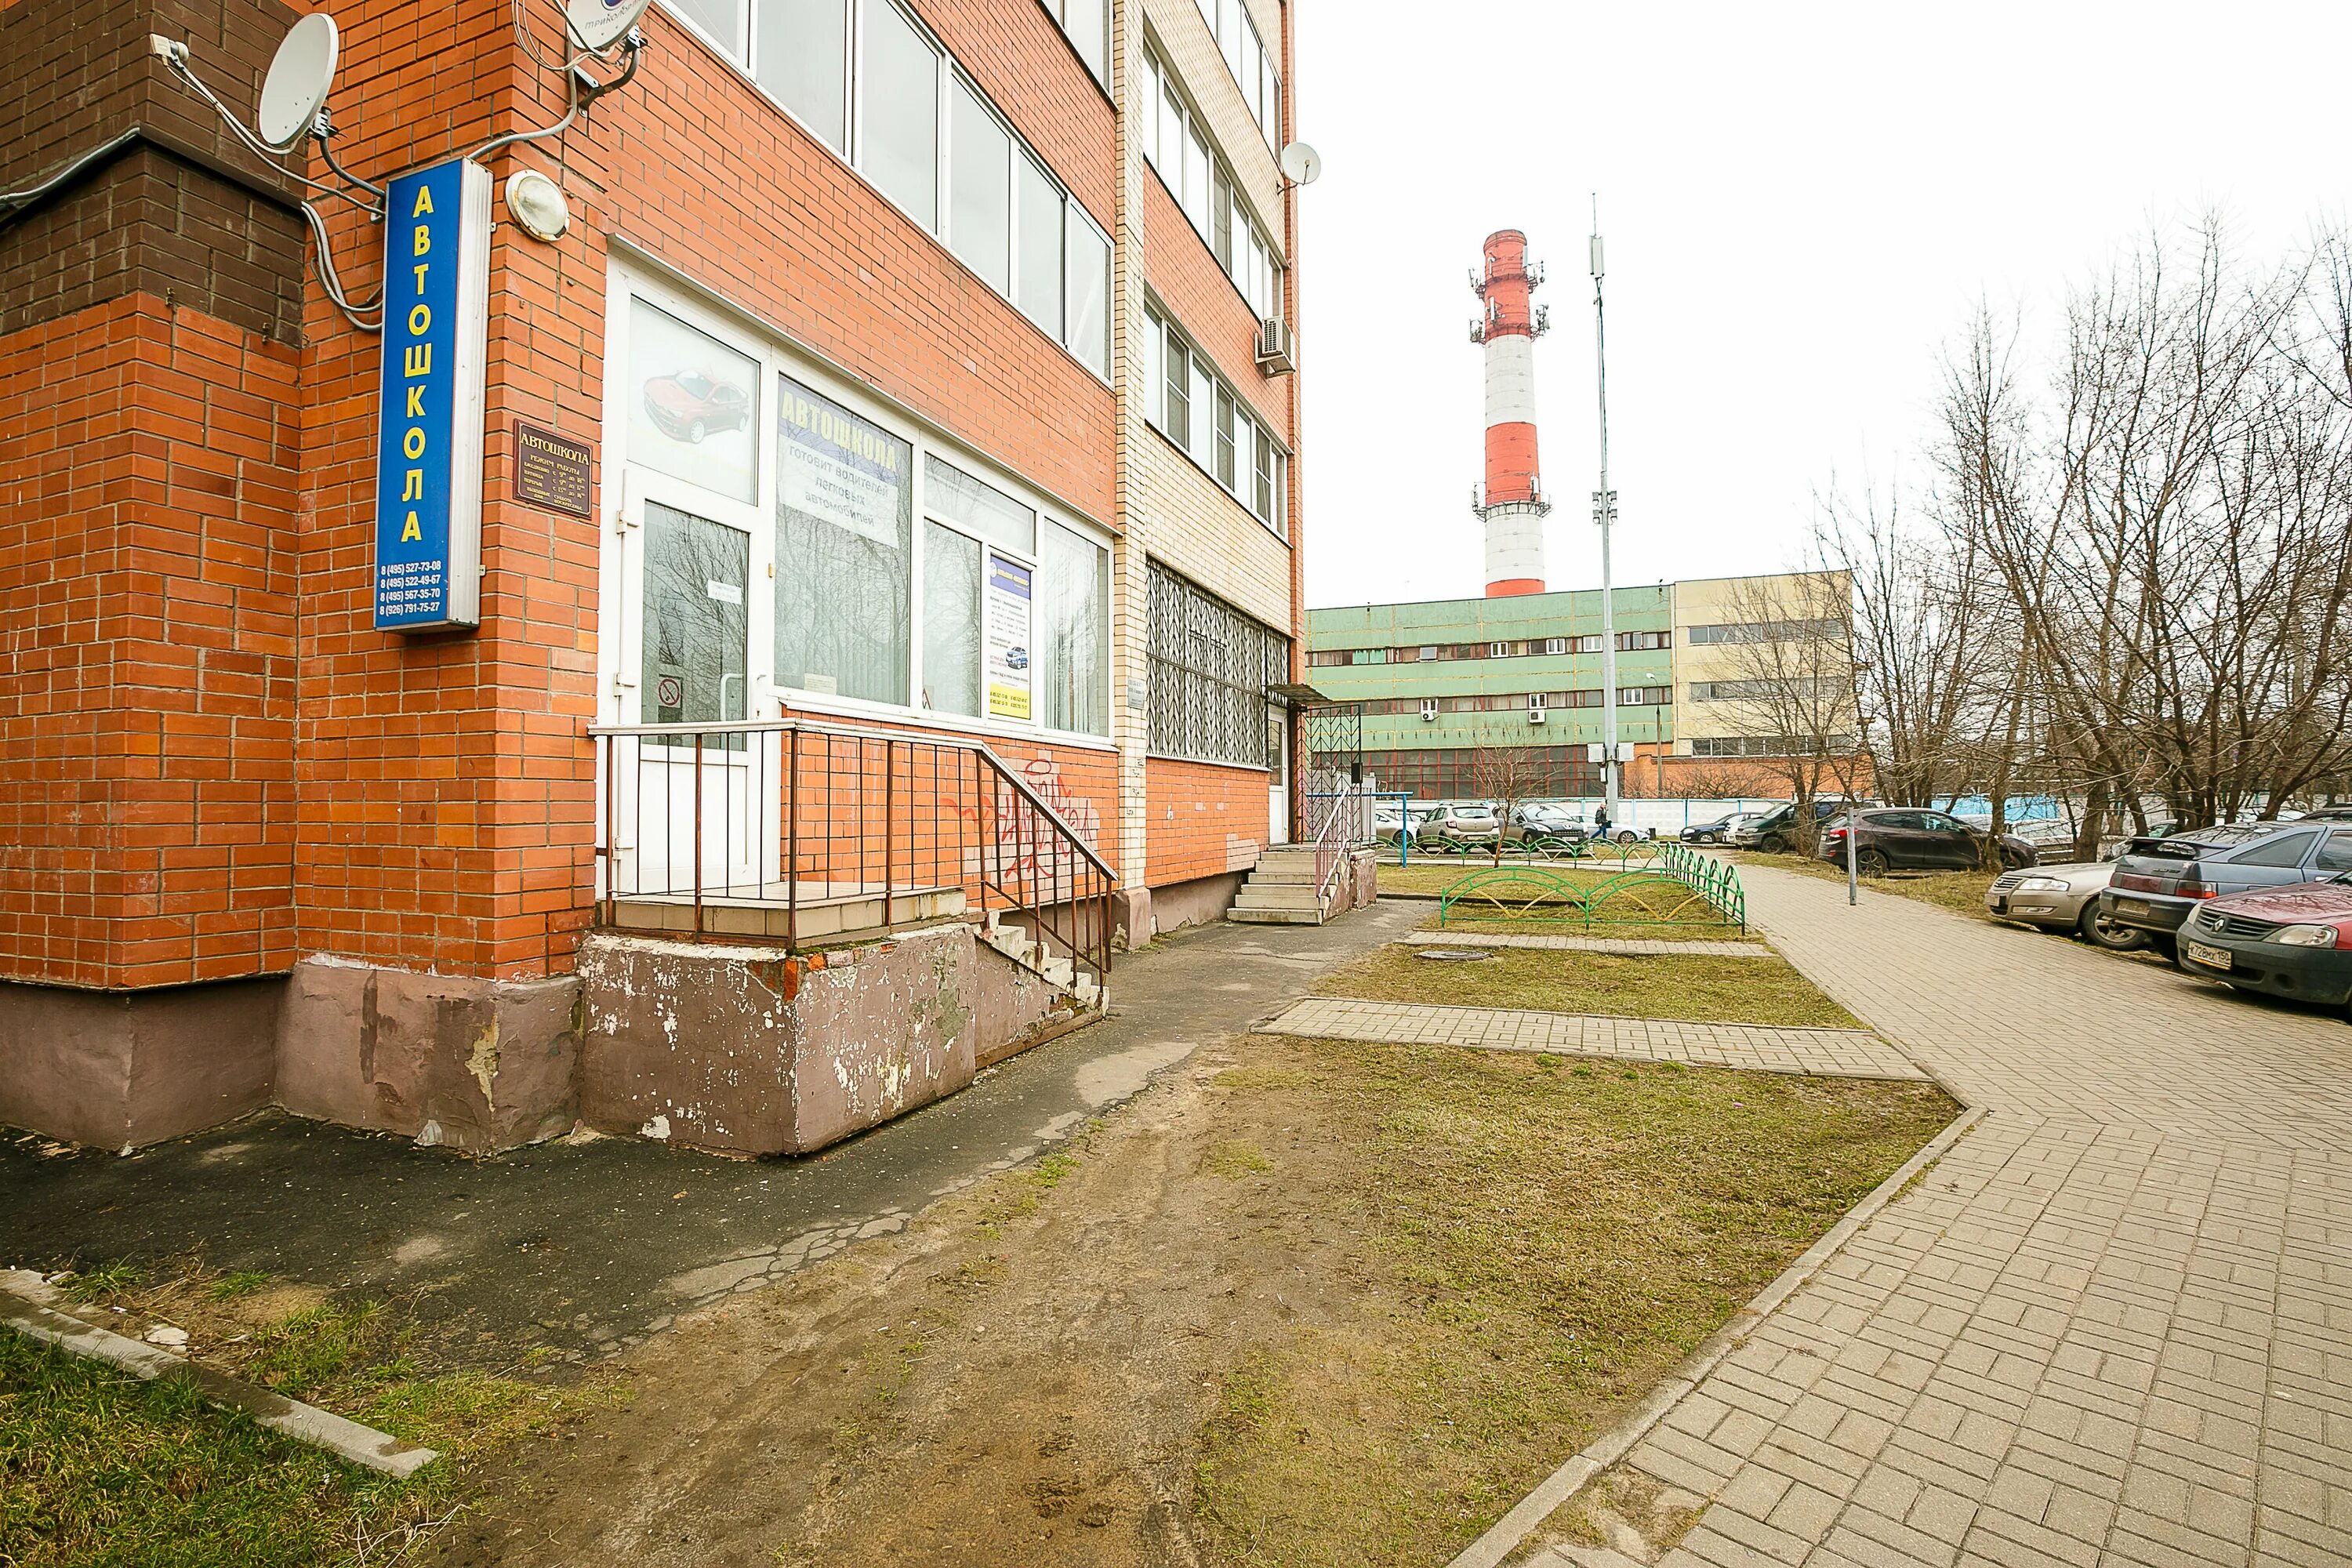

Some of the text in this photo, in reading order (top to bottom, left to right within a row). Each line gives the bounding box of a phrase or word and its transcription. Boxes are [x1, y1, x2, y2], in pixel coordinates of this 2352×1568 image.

[401, 185, 434, 543] АВТОШКОЛА
[782, 391, 896, 470] АВТОШКОЛА
[521, 433, 589, 466] АВТОШКОЛА
[530, 454, 580, 476] РЕЖИМ РАБОТЫ
[815, 477, 866, 506] легковых
[836, 467, 888, 497] водителей
[805, 492, 874, 527] автомобилей
[380, 560, 441, 577] 8 (495) 527-73-08
[380, 574, 441, 590] 8 (495) 522-49-67
[379, 587, 441, 604] 8 (495) 567-35-70
[379, 601, 440, 617] 8 (926) 791-75-27
